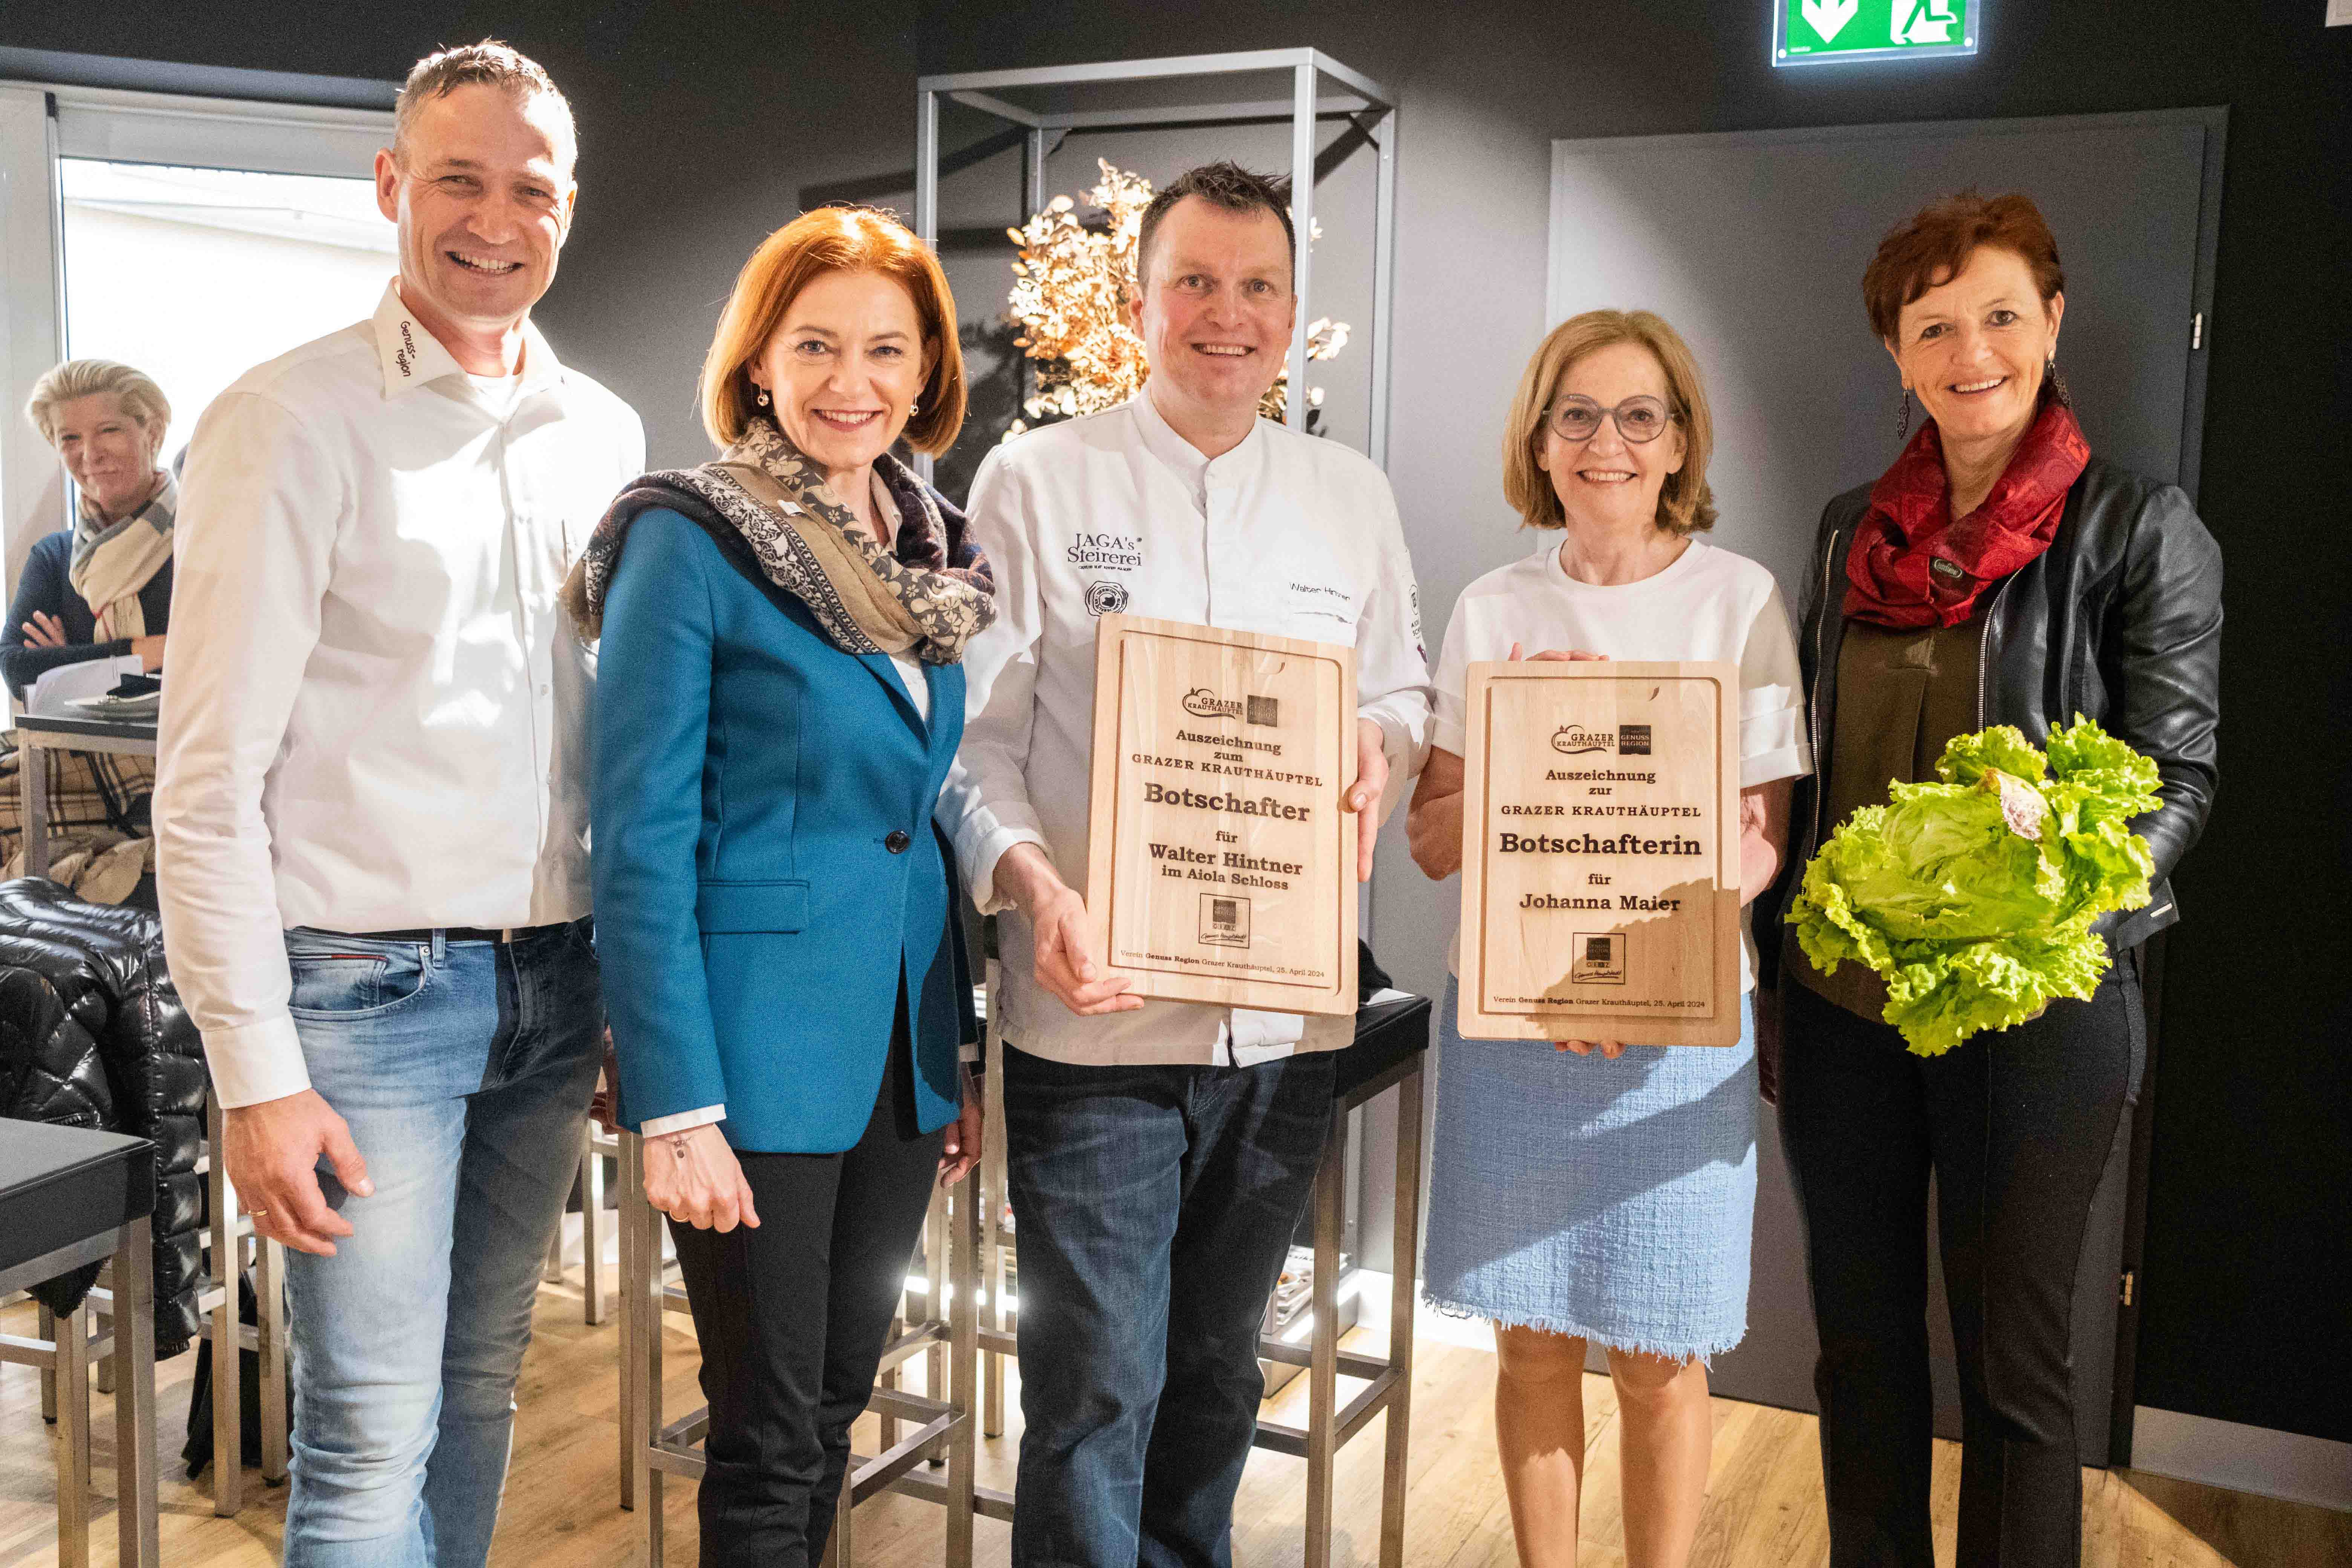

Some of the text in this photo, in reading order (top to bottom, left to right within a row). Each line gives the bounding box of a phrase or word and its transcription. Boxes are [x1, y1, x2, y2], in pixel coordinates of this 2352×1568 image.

[401, 321, 415, 359] Genuss-
[396, 349, 411, 377] region
[1076, 533, 1134, 551] JAGA's
[1067, 546, 1142, 566] Steirerei
[1289, 582, 1321, 593] Walter
[1201, 697, 1242, 709] GRAZER
[1176, 729, 1282, 755] Auszeichnung
[1214, 752, 1243, 763] zum
[1132, 754, 1323, 787] GRAZER KRAUTHÄUPTEL
[1545, 769, 1656, 784] Auszeichnung
[1589, 786, 1612, 795] zur
[1144, 782, 1310, 822] Botschafter
[1501, 804, 1701, 817] GRAZER KRAUTHÄUPTEL
[1216, 830, 1238, 843] für
[1499, 833, 1702, 856] Botschafterin
[1148, 843, 1303, 875] Walter Hintner
[1162, 865, 1289, 890] im Aiola Schloss
[1588, 873, 1611, 885] für
[1519, 894, 1681, 911] Johanna Maier
[1121, 950, 1143, 958] Verein
[1145, 953, 1172, 961] Genuss
[1289, 968, 1306, 976] April
[1602, 999, 1651, 1008] Krauthäuptel,
